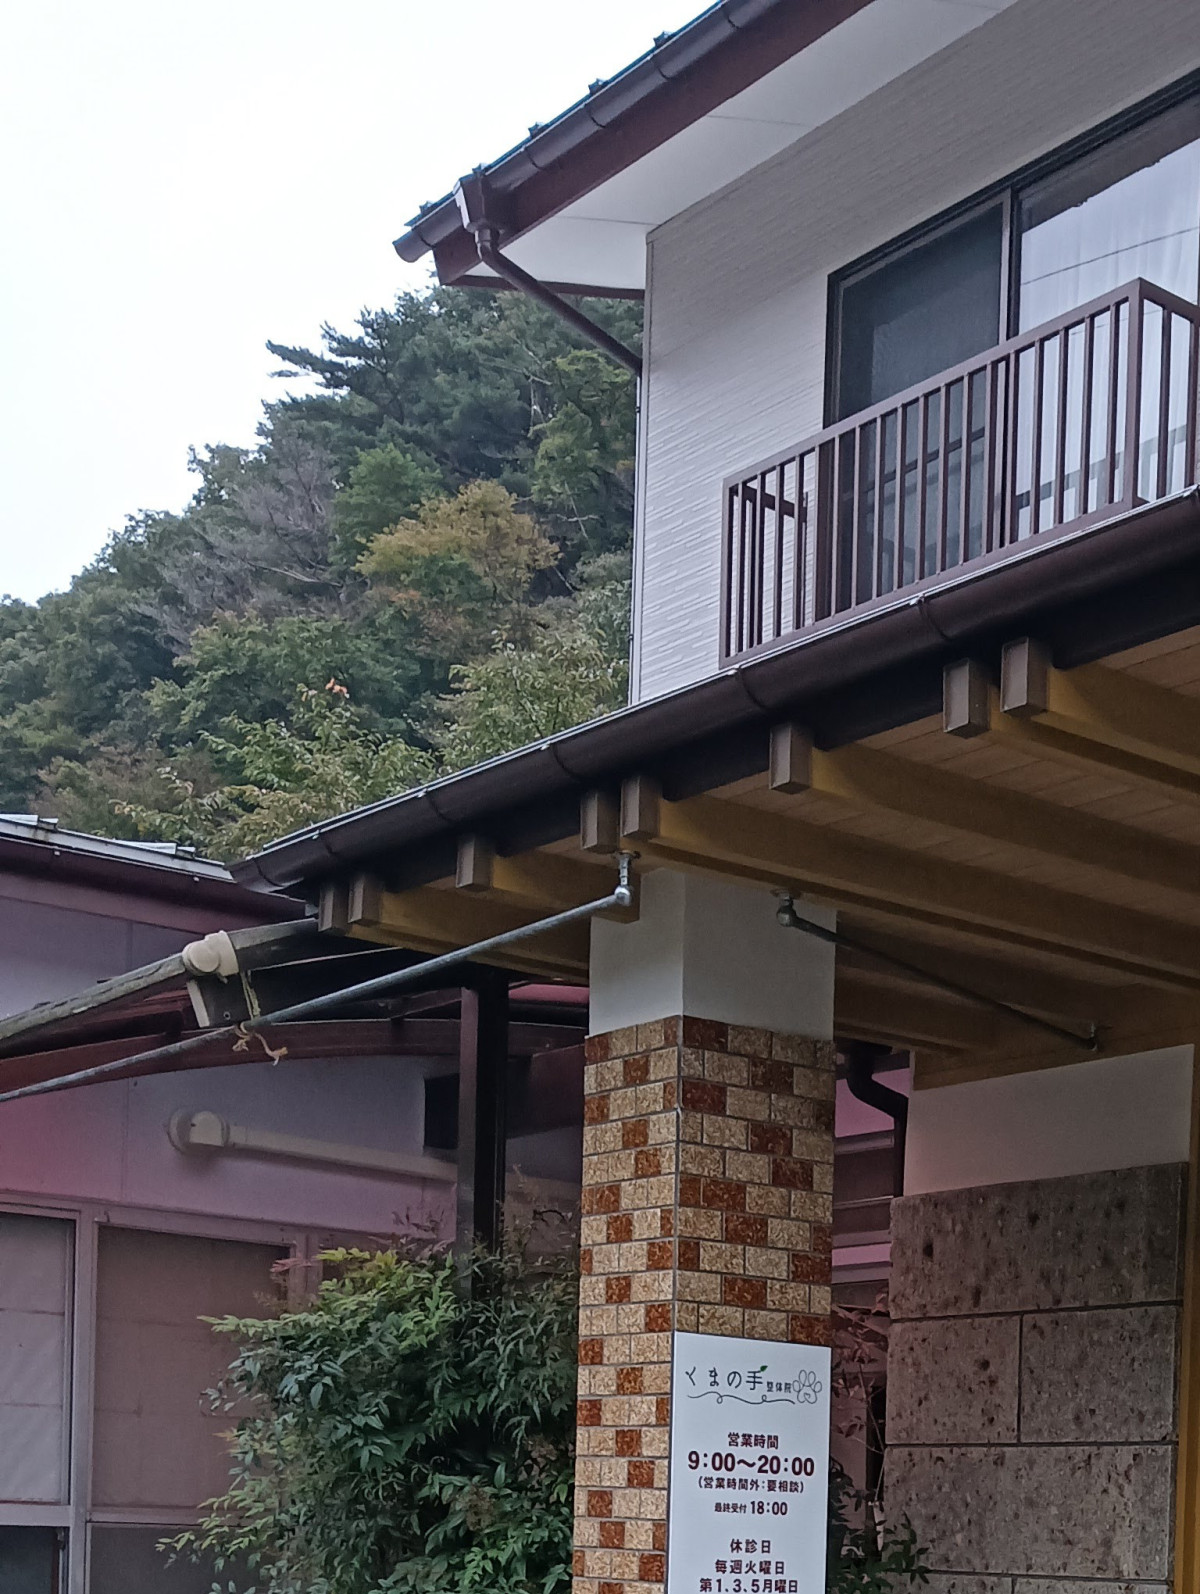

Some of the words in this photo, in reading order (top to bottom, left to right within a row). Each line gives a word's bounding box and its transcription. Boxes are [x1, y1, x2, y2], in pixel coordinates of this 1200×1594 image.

[685, 1365, 763, 1391] くまの手
[727, 1432, 779, 1450] 営業時間
[687, 1450, 815, 1478] 9:00～20:00
[697, 1475, 805, 1494] (営業時間外:要相談)
[714, 1502, 748, 1515] 最終受付
[750, 1500, 789, 1516] 18:00
[729, 1538, 772, 1554] 休診日
[714, 1559, 785, 1576] 毎週火曜日
